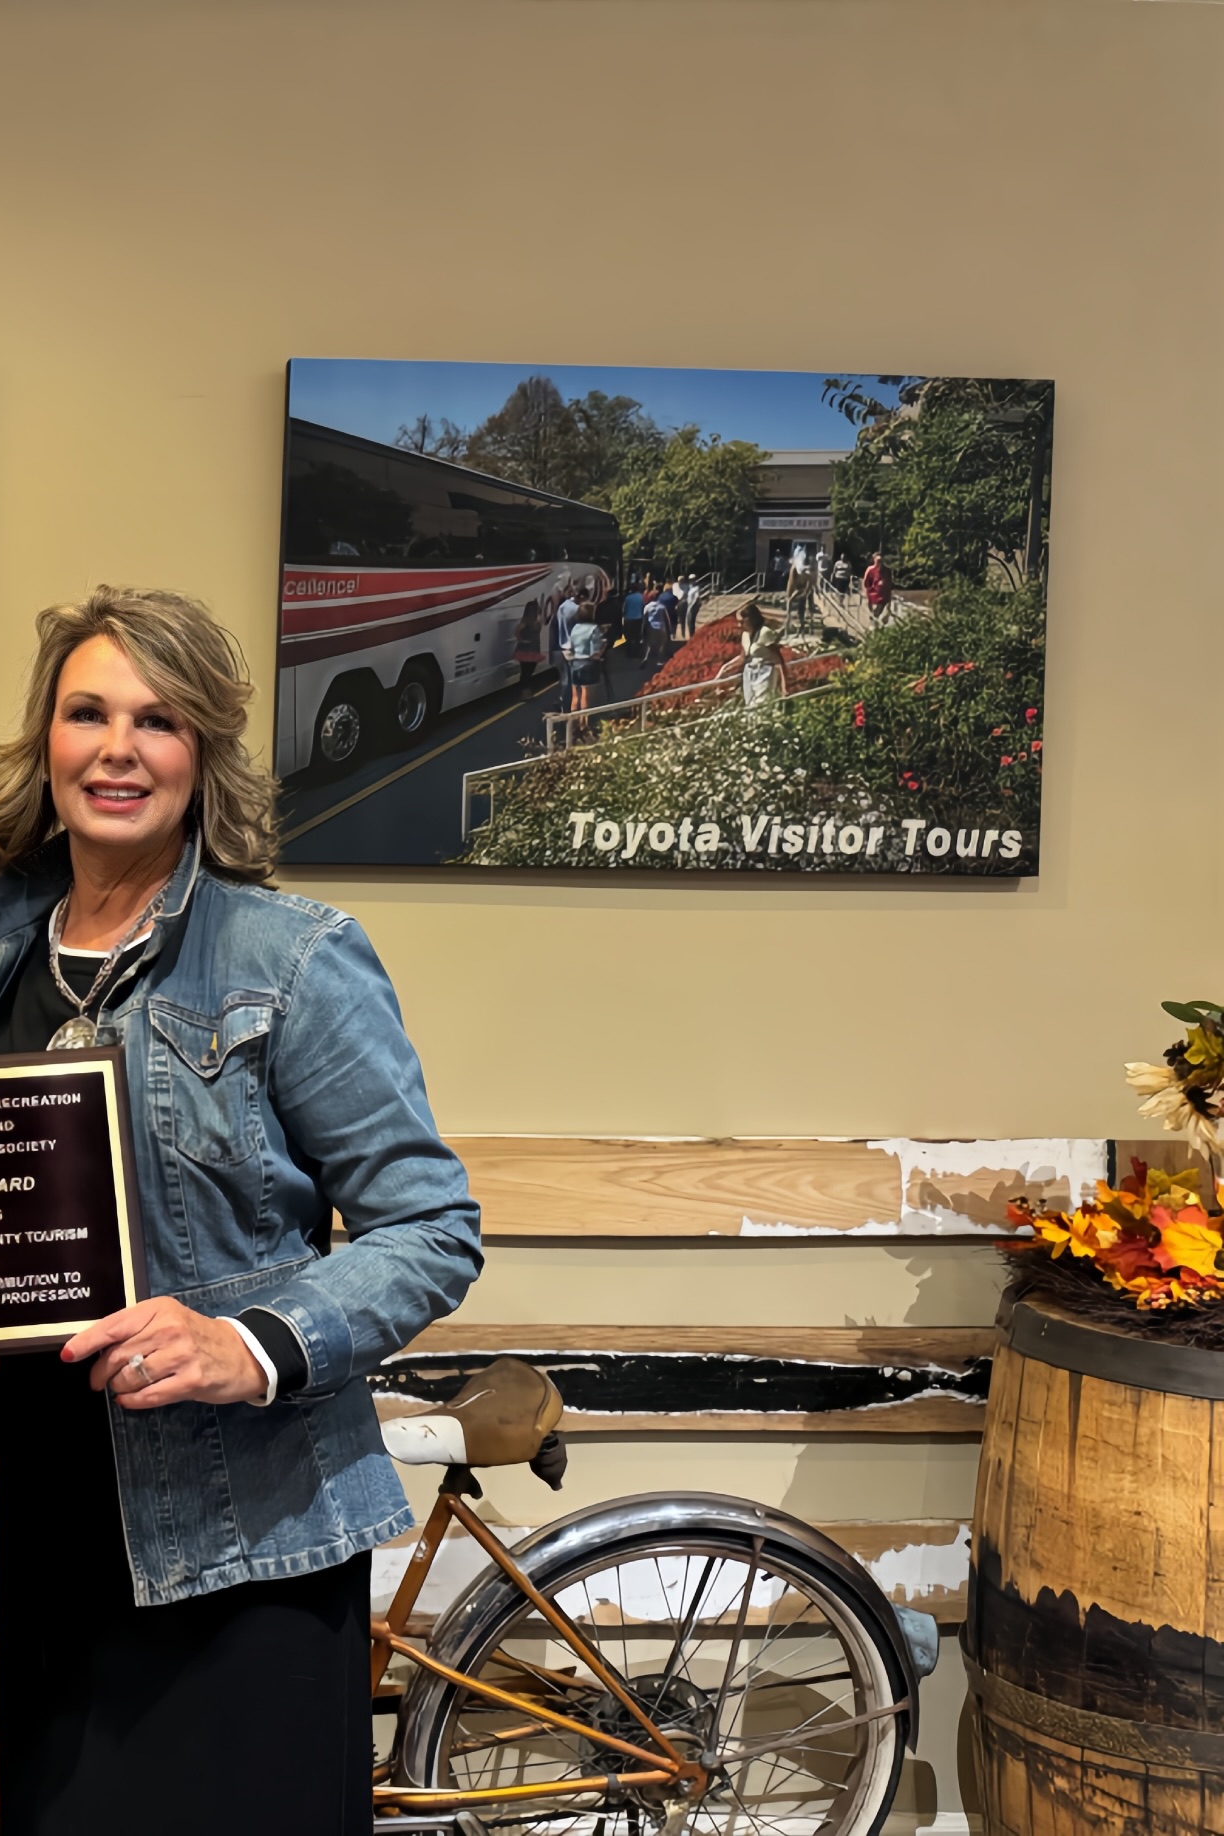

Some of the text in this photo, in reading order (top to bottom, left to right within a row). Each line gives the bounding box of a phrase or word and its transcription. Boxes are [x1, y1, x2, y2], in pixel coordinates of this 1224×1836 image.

[568, 812, 1023, 860] Toyota Visitor Tours
[25, 1227, 88, 1243] TOURISM
[63, 1271, 81, 1283] TO
[1, 1287, 91, 1305] PROFESSION
